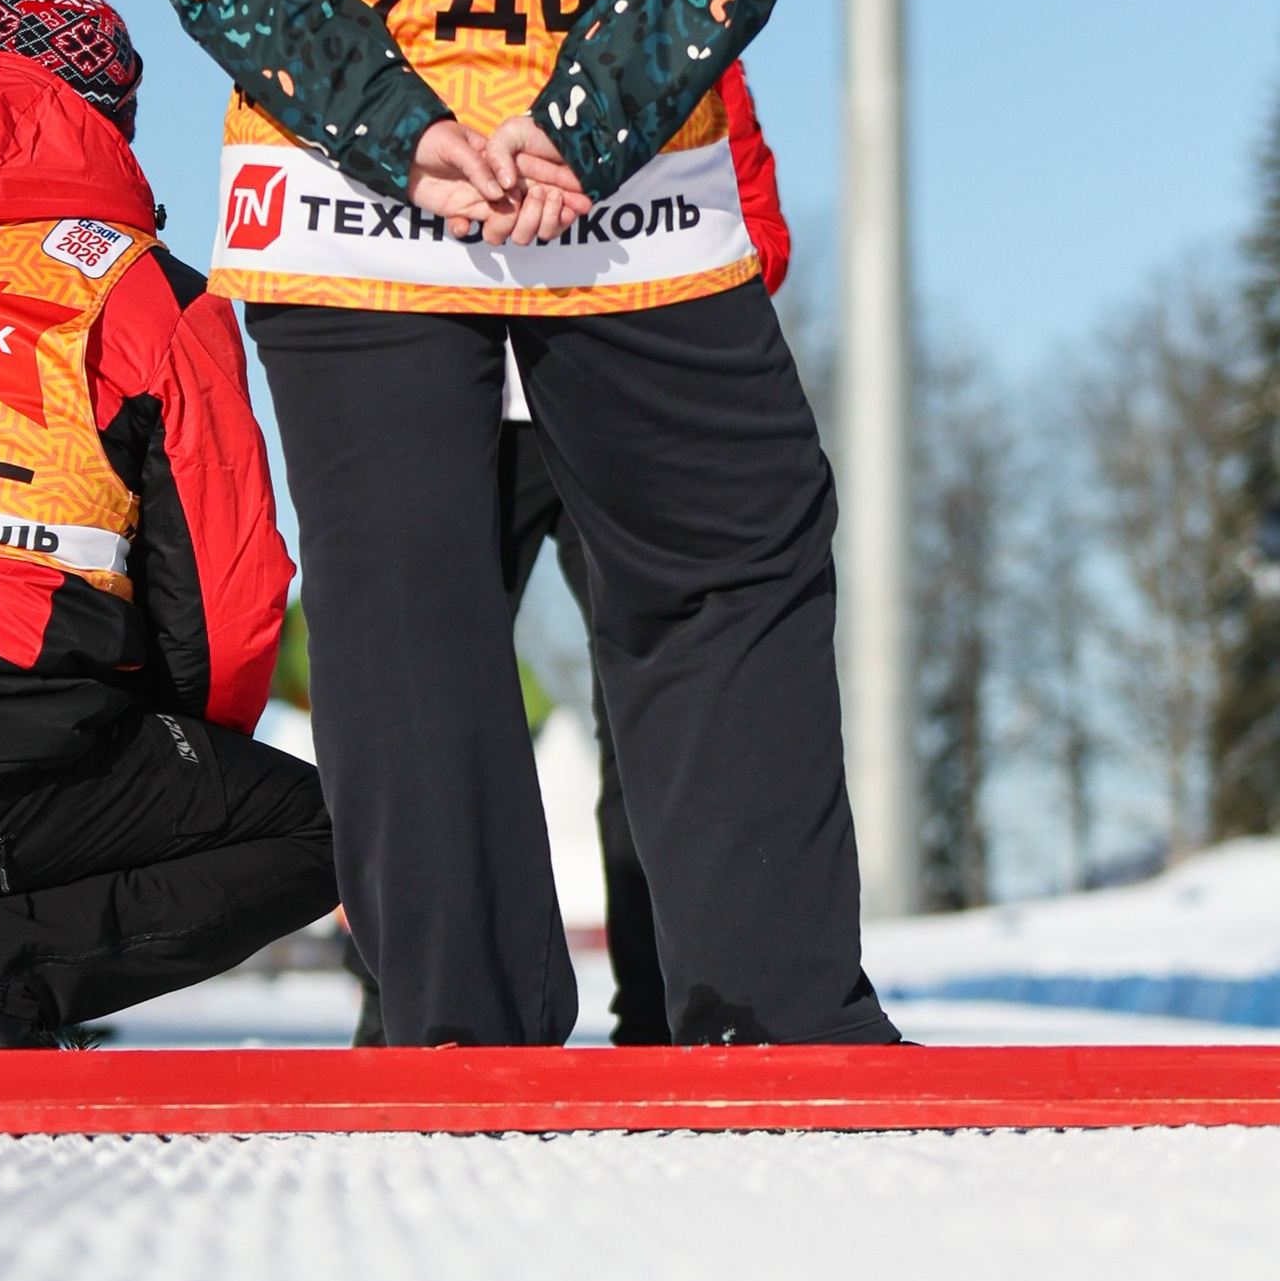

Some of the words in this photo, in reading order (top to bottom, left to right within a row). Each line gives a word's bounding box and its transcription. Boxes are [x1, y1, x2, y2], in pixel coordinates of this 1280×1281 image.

[78, 218, 121, 243] СЕЗОН
[300, 194, 700, 246] ТЕХНКОЛЬ
[56, 237, 101, 266] 2026
[67, 226, 112, 254] 2025
